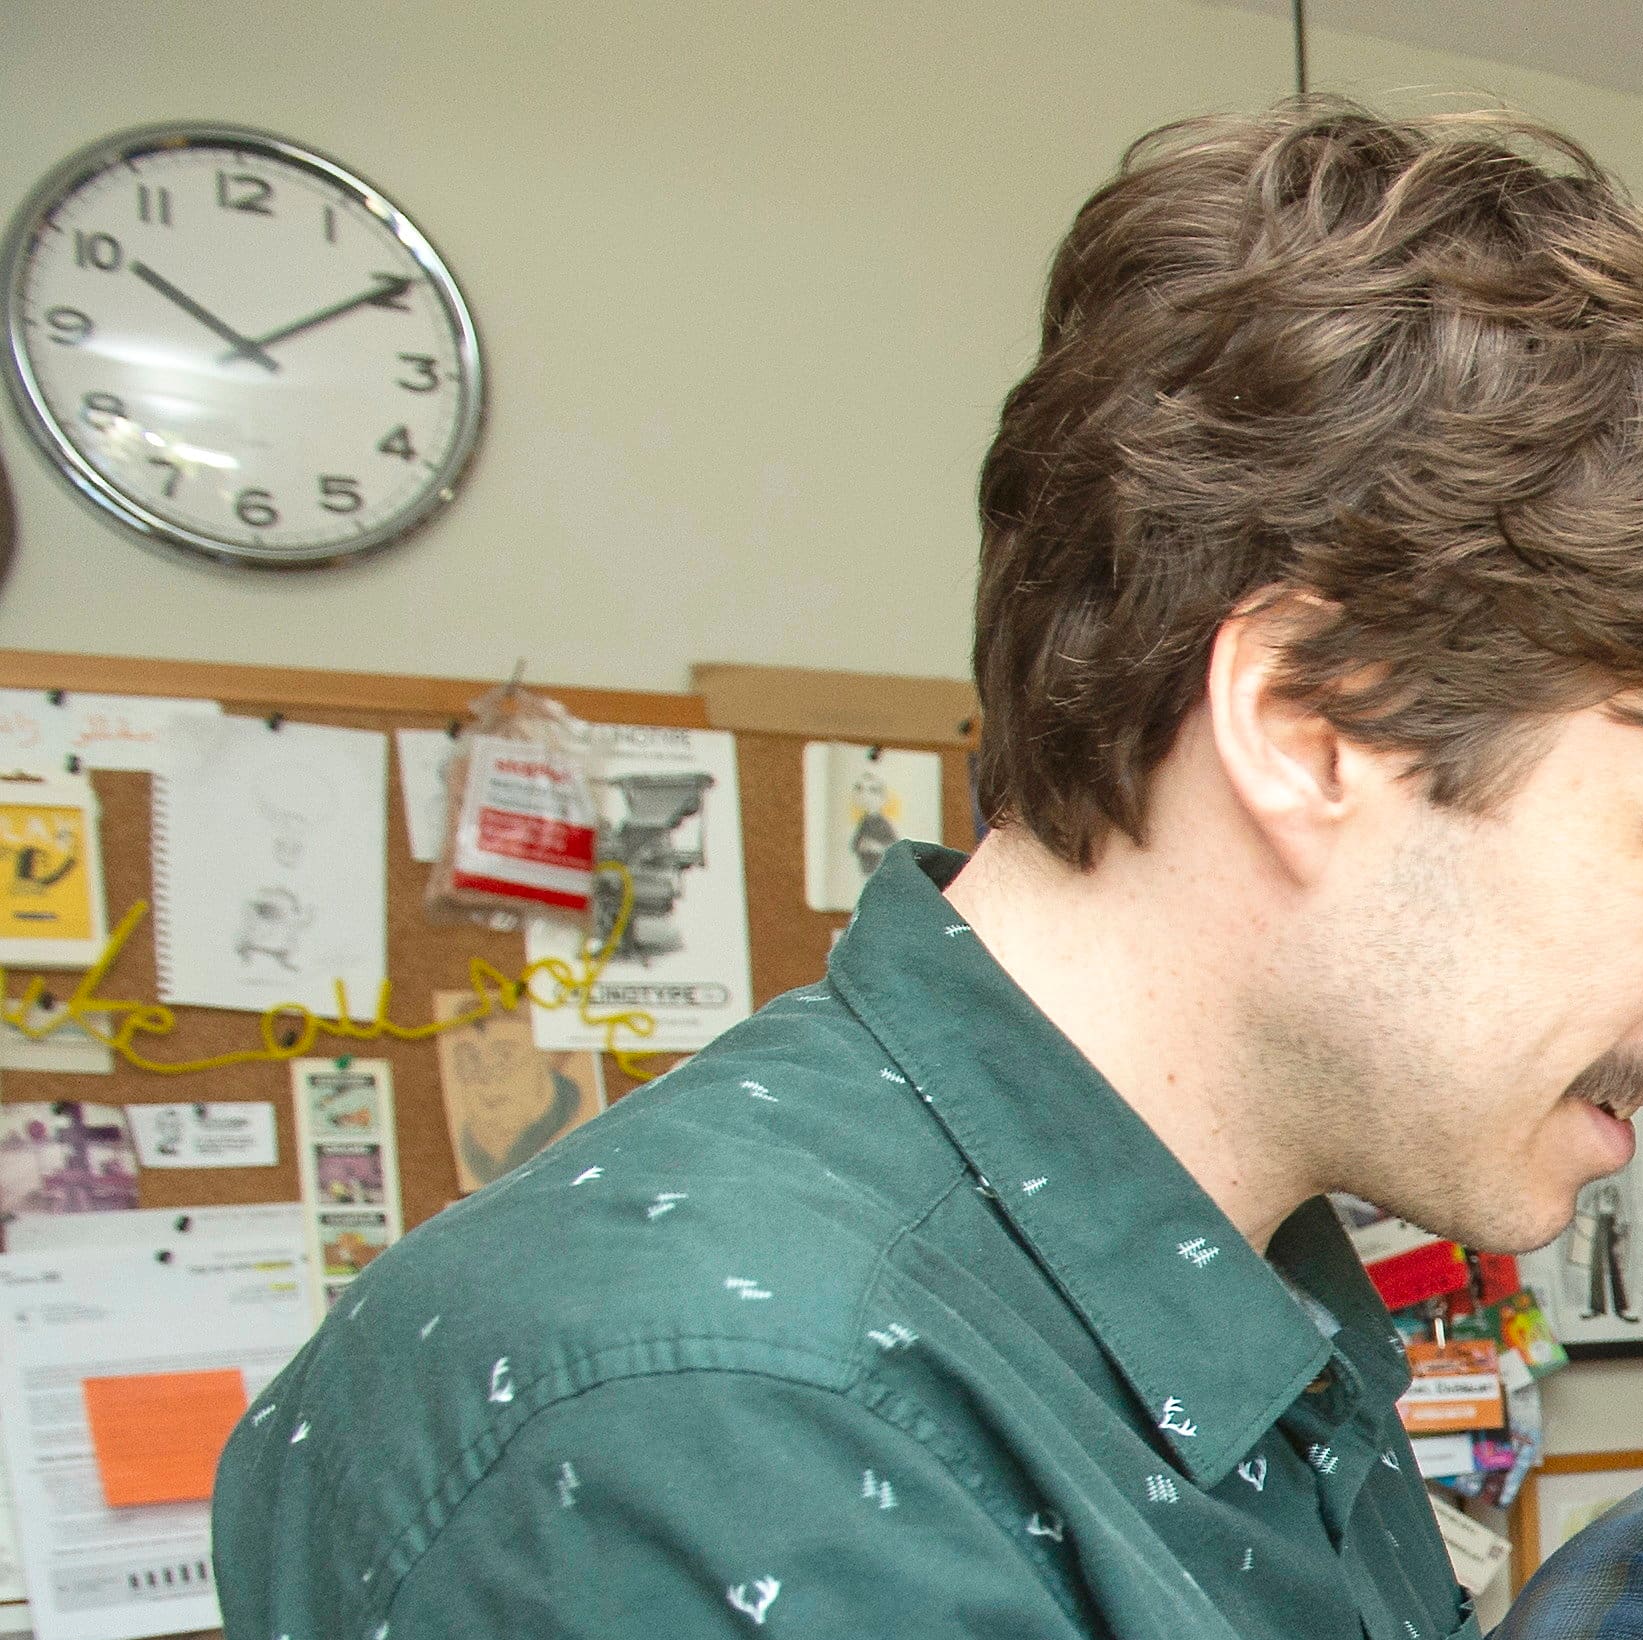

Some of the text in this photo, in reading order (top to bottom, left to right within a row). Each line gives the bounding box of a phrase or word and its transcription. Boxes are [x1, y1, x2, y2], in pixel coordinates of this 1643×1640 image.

[137, 184, 172, 227] 11
[217, 171, 274, 217] 12
[322, 205, 339, 243] 1
[73, 230, 124, 273] 10
[46, 307, 94, 347] 9
[398, 353, 439, 395] 3
[82, 390, 128, 430] 8
[379, 426, 416, 461] 4
[149, 457, 186, 498] 7
[319, 474, 364, 514] 5
[234, 487, 278, 528] 6
